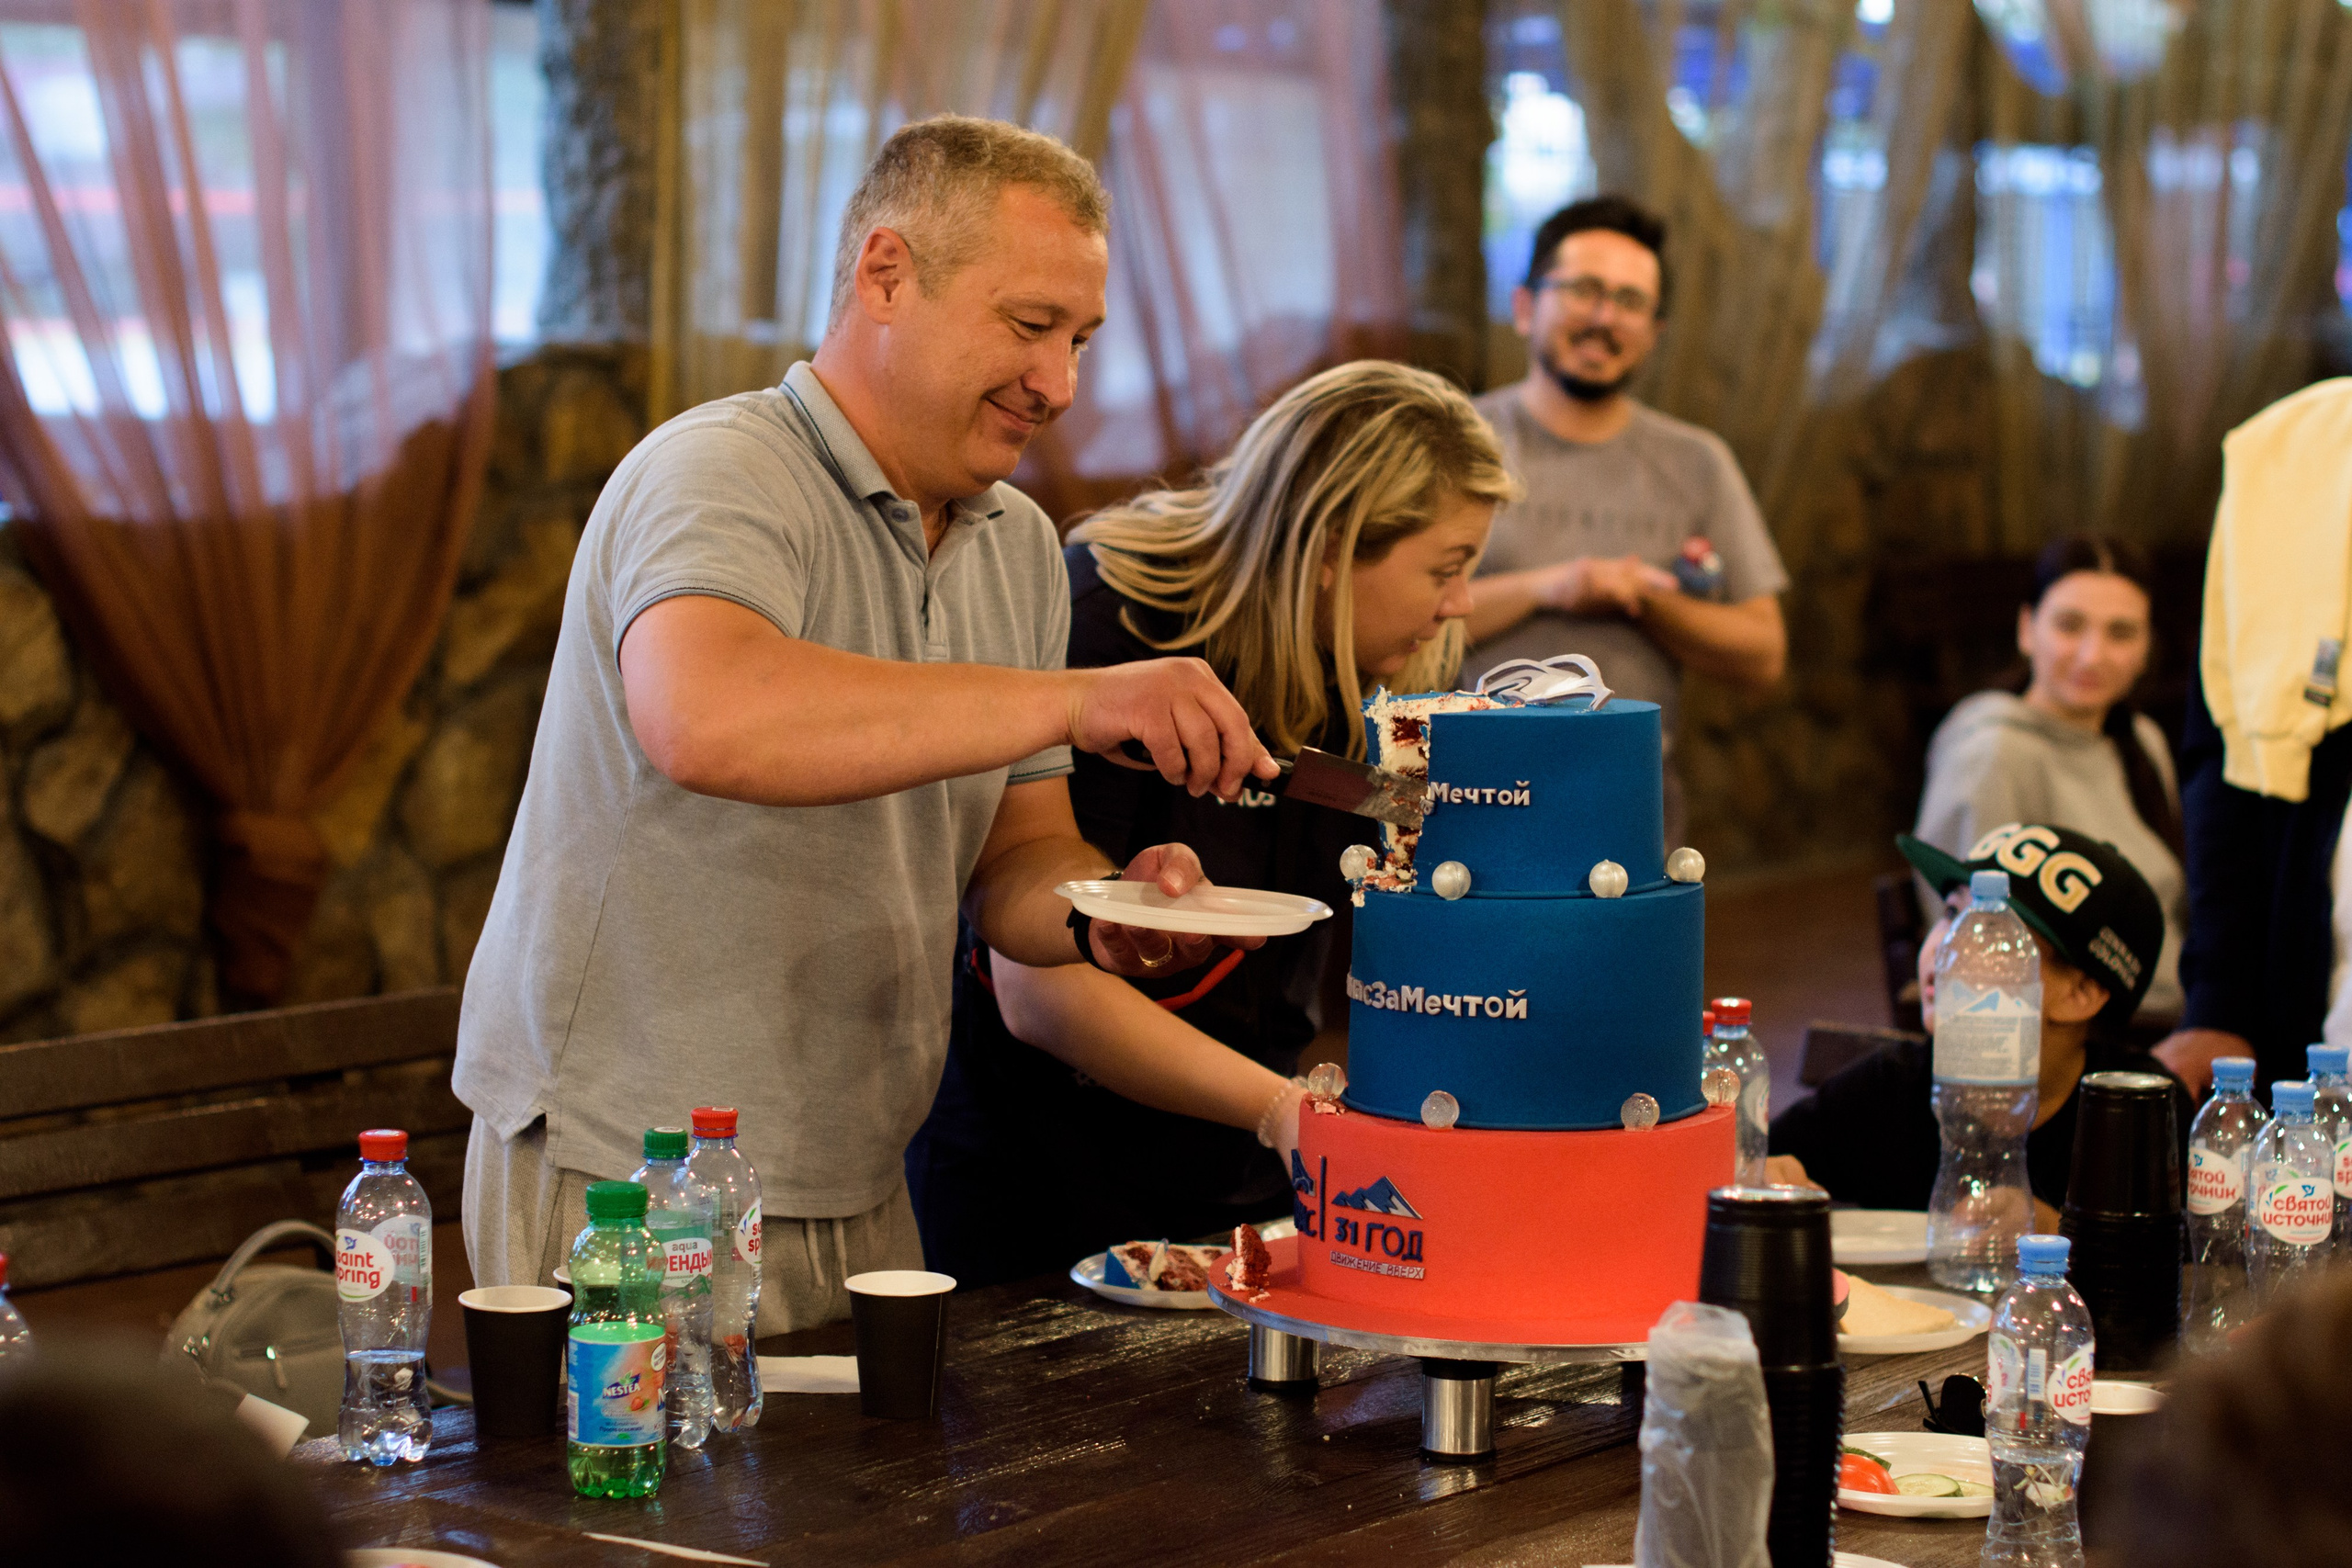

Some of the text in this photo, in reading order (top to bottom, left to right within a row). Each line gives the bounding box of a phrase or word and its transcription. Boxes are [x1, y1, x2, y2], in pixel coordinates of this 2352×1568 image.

[2262, 1211, 2332, 1227] источни
[672, 1242, 698, 1253] aqua
[1335, 1216, 1423, 1263] 31 ГОД
[1330, 1251, 1423, 1280] ДВИЖЕНИЕ ВВЕРХ
[602, 1383, 642, 1397] NESTEA
